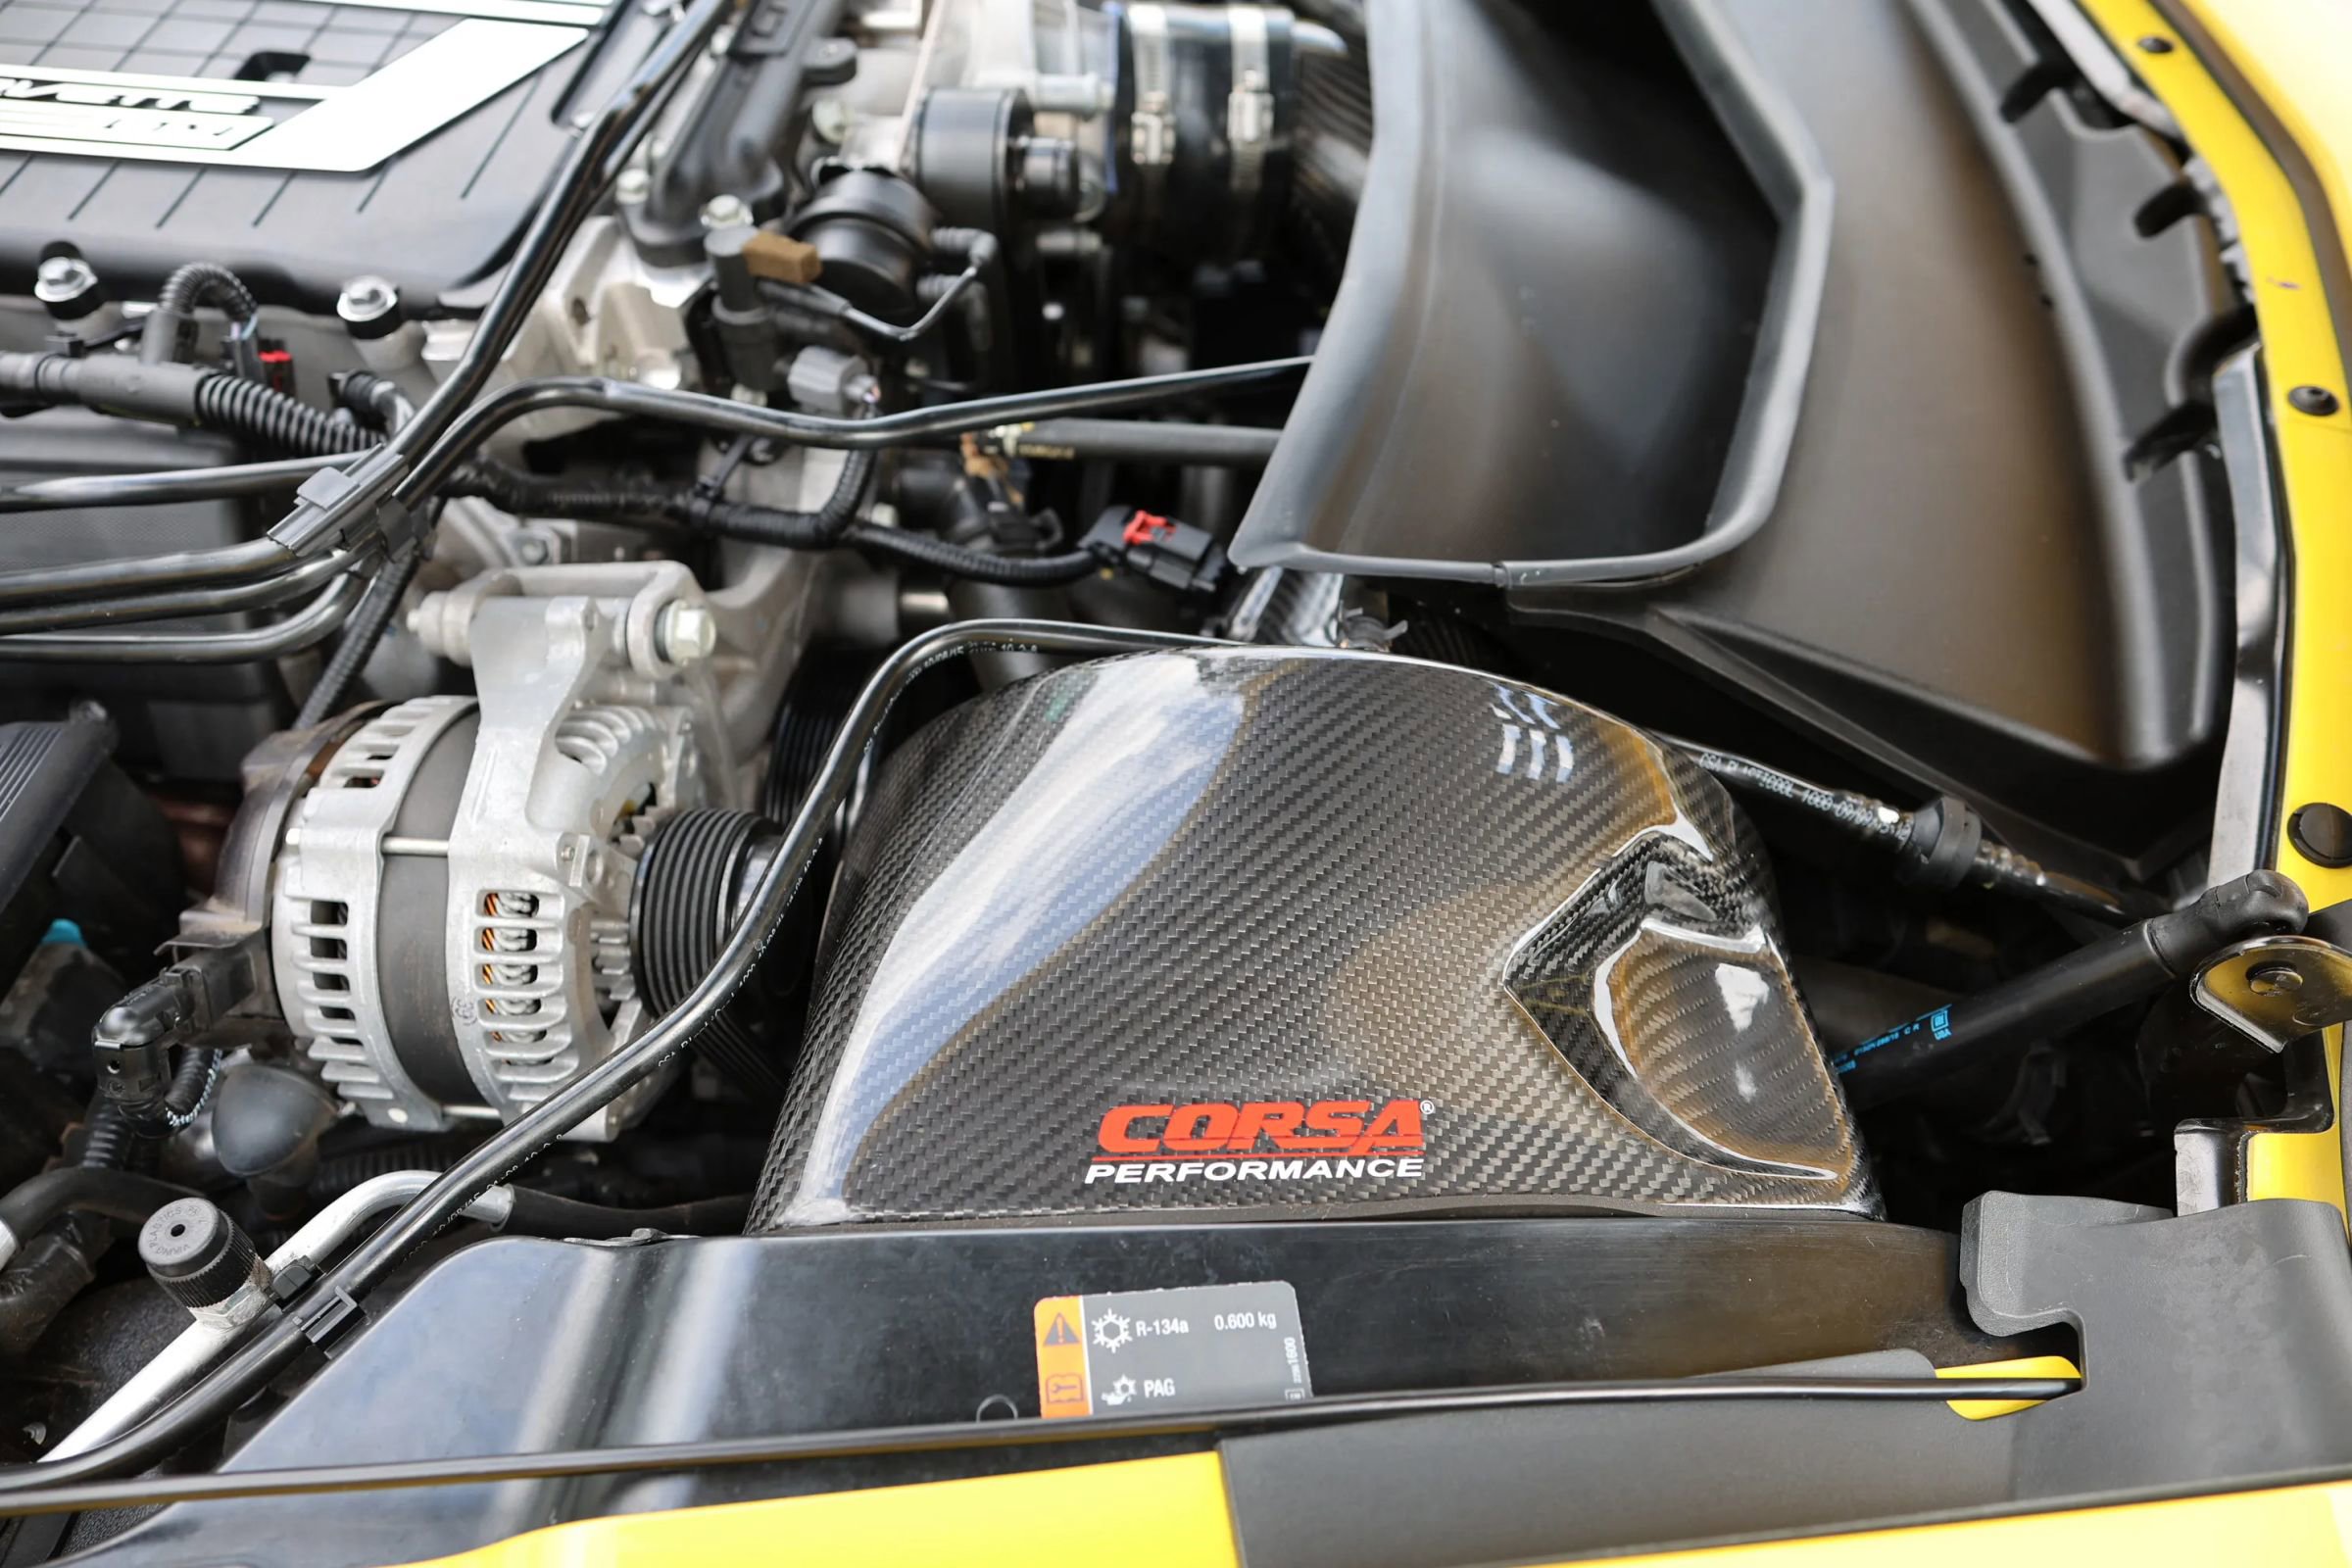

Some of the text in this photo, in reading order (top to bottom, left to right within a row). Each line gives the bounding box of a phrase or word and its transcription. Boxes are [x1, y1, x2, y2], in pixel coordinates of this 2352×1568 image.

[1084, 1157, 1425, 1185] PERFORMANCE
[1136, 1311, 1277, 1337] R-134a 0.600 kg
[1144, 1378, 1175, 1398] PAG
